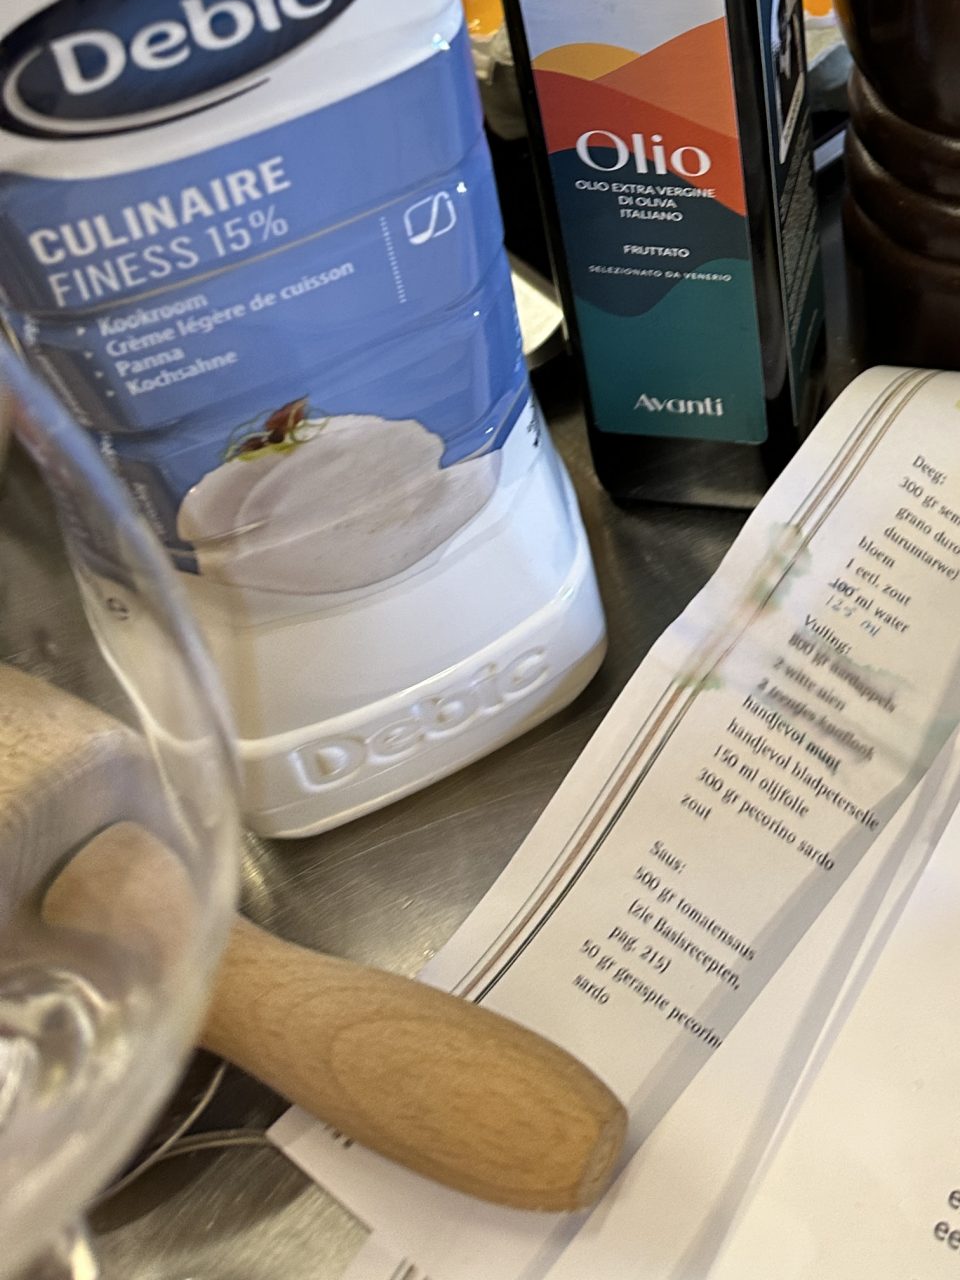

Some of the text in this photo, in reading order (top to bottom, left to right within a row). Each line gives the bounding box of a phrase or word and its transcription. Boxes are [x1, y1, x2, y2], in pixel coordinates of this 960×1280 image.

[576, 130, 711, 177] Olio
[575, 180, 717, 199] OLIO EXTRA VERGINE
[618, 195, 678, 209] DI OLIVA
[28, 156, 292, 266] CULINAIRE
[620, 208, 683, 222] ITALIANO
[48, 205, 289, 308] FINESS 15%
[623, 245, 690, 258] FRUTTATO
[247, 289, 277, 313] de
[279, 260, 354, 301] cuisson
[98, 293, 208, 337] Kookroom
[114, 345, 184, 379] Panna
[125, 348, 239, 396] Kochsahne
[633, 393, 724, 417] Avanti
[912, 455, 948, 486] Deeg:
[899, 476, 923, 499] 300
[922, 492, 938, 510] gr
[895, 507, 932, 540] grano
[857, 535, 896, 569] bloem
[883, 525, 960, 582] durumtarwe)
[854, 587, 874, 612] ml
[875, 604, 911, 635] water
[882, 582, 911, 608] zout
[804, 613, 852, 656] Vulling:
[288, 647, 552, 792] Debic
[742, 695, 806, 746] handjevol
[712, 743, 739, 770] 150
[738, 762, 757, 783] ml
[727, 717, 791, 771] handjevol
[680, 793, 713, 822] zout
[696, 766, 836, 871] 300 gr pecorino sardo
[649, 839, 688, 875] Saus:
[634, 866, 757, 962] 500 gr tomatensaus
[572, 973, 611, 1006] sardo
[579, 938, 724, 1050] 50 gr geraspte pecorin
